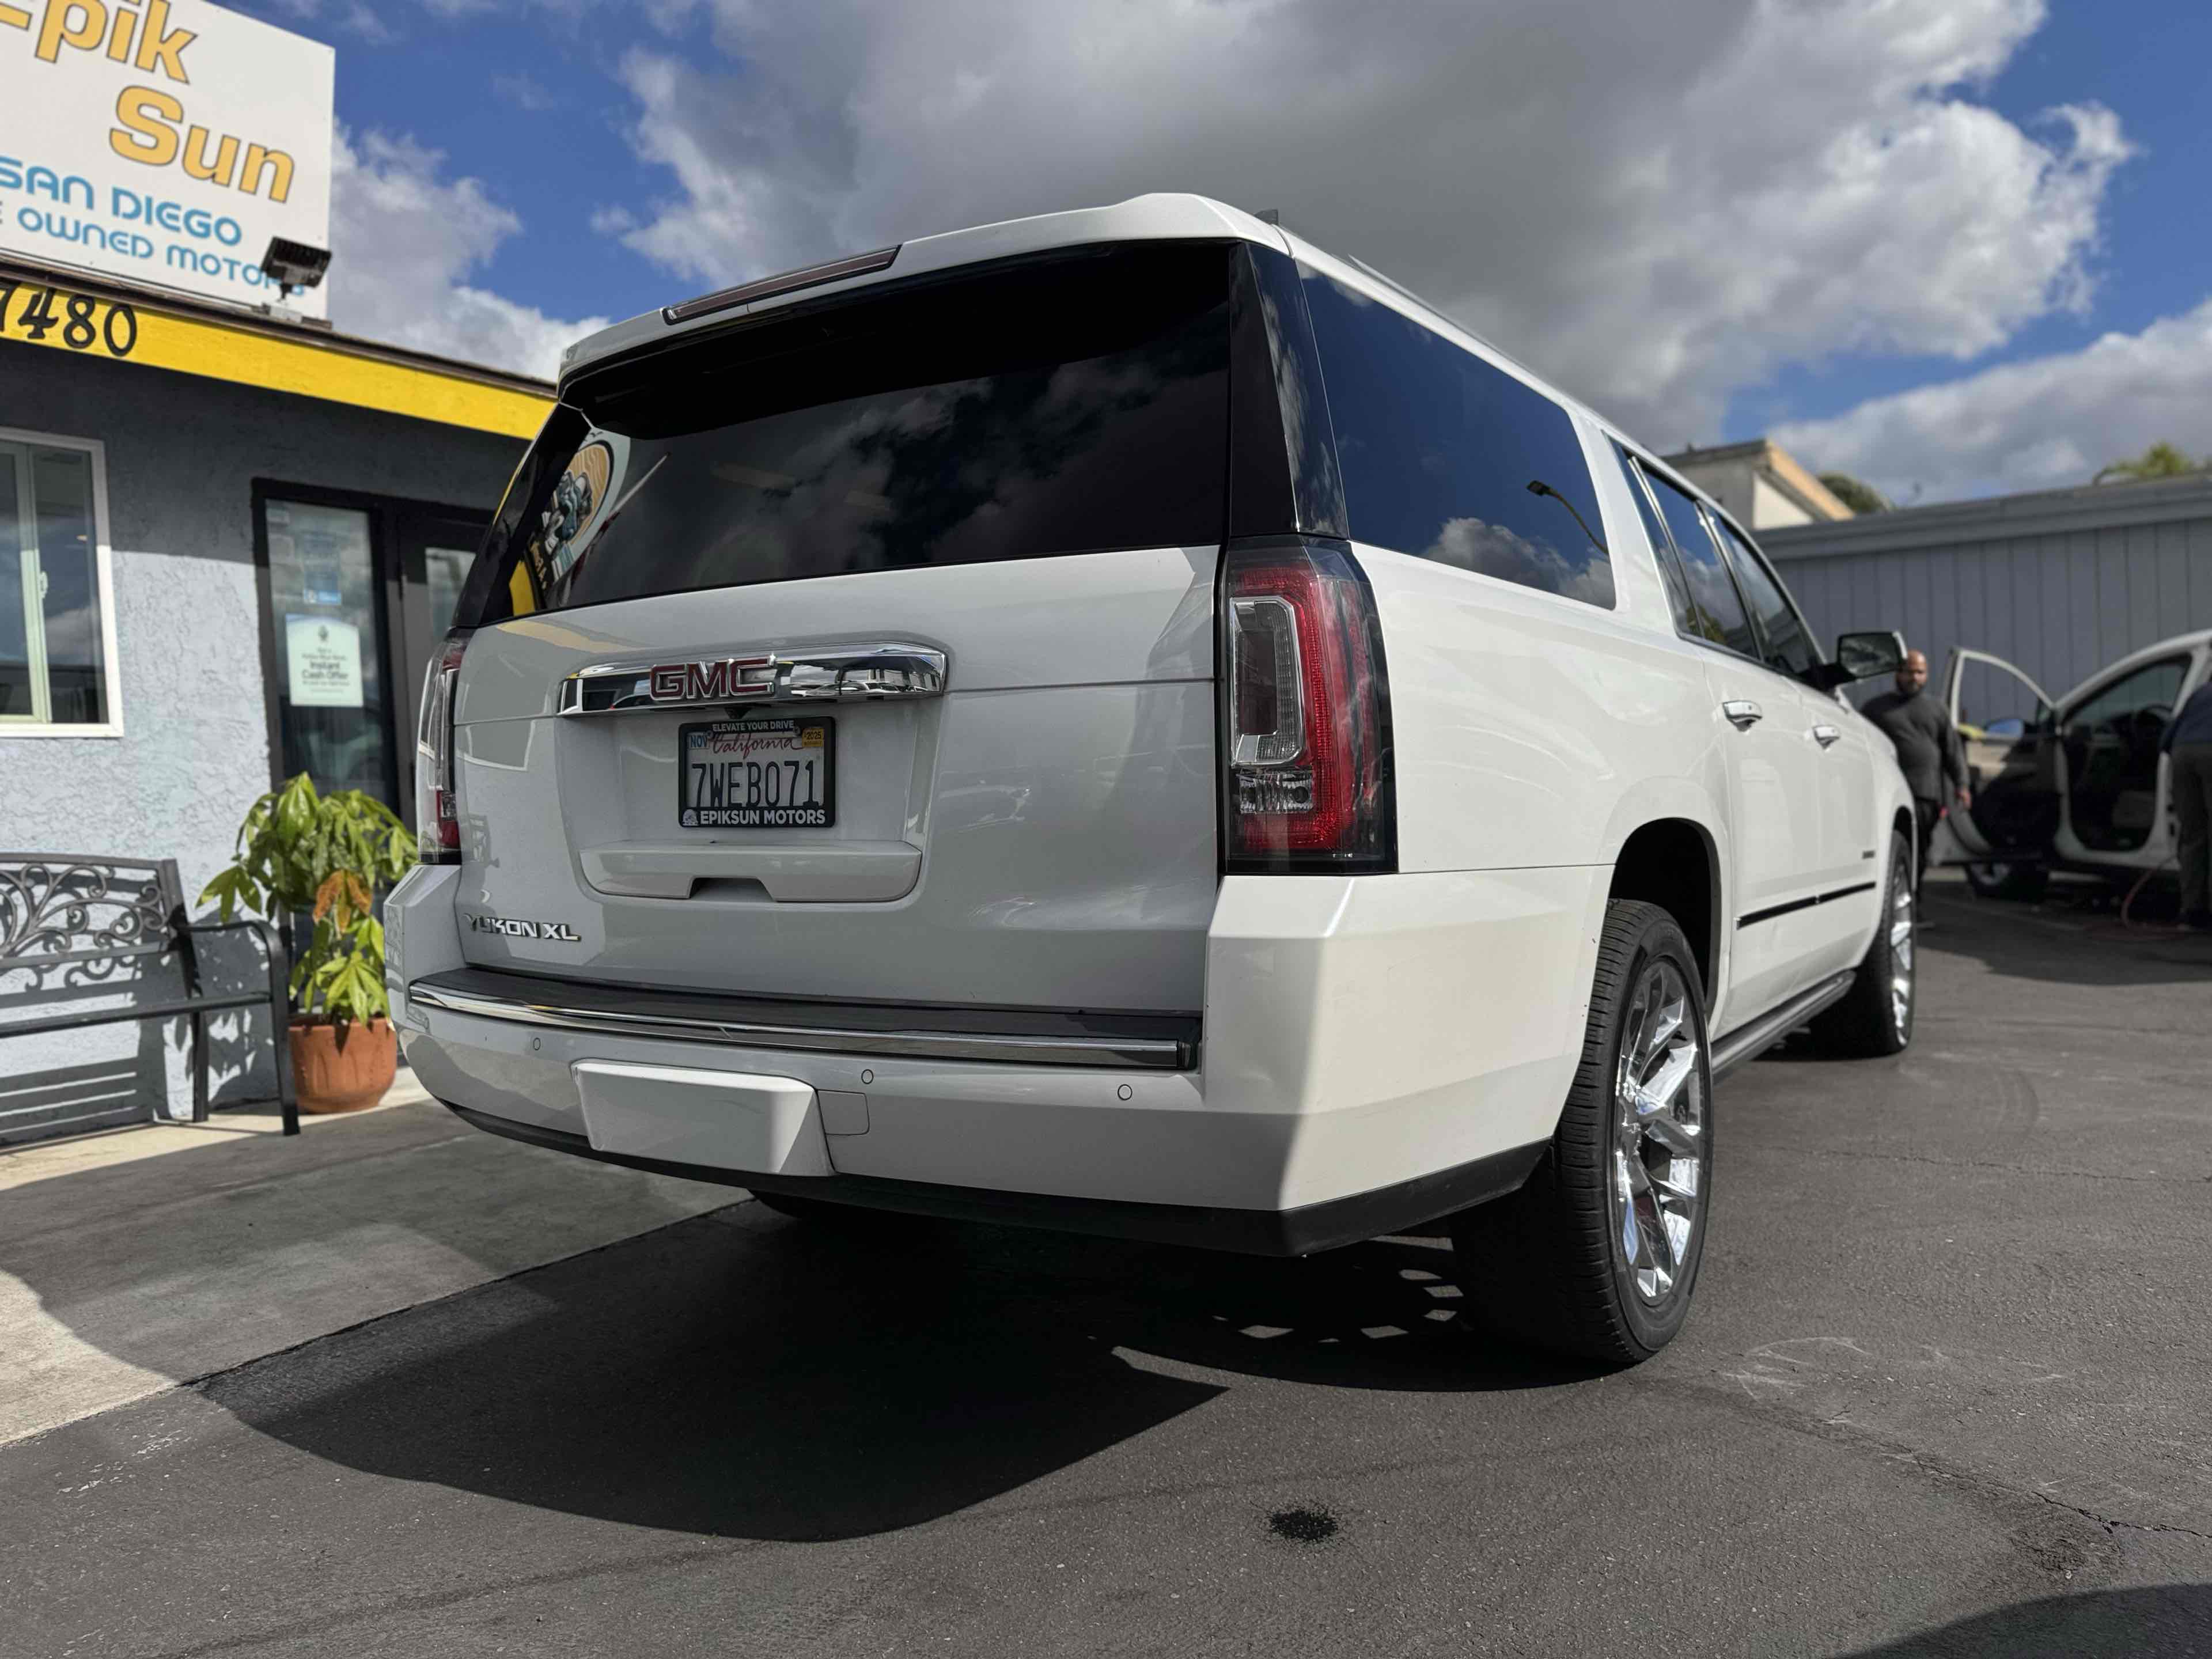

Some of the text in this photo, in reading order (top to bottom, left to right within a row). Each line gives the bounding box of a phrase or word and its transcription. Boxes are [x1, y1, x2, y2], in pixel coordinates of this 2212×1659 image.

[0, 0, 199, 85] pik
[109, 85, 295, 203] Sun
[0, 156, 242, 247] SAN DIEGO
[17, 207, 154, 259] OWNED
[166, 244, 305, 296] MOTO
[650, 656, 777, 701] GMC
[708, 733, 804, 759] California
[712, 720, 794, 732] ELEVATE YOUR DRIVE
[806, 731, 821, 740] 2025
[692, 760, 820, 807] 7WEB071
[700, 809, 825, 825] EPIKSUN MOTORS
[464, 913, 581, 941] YUKON XL
